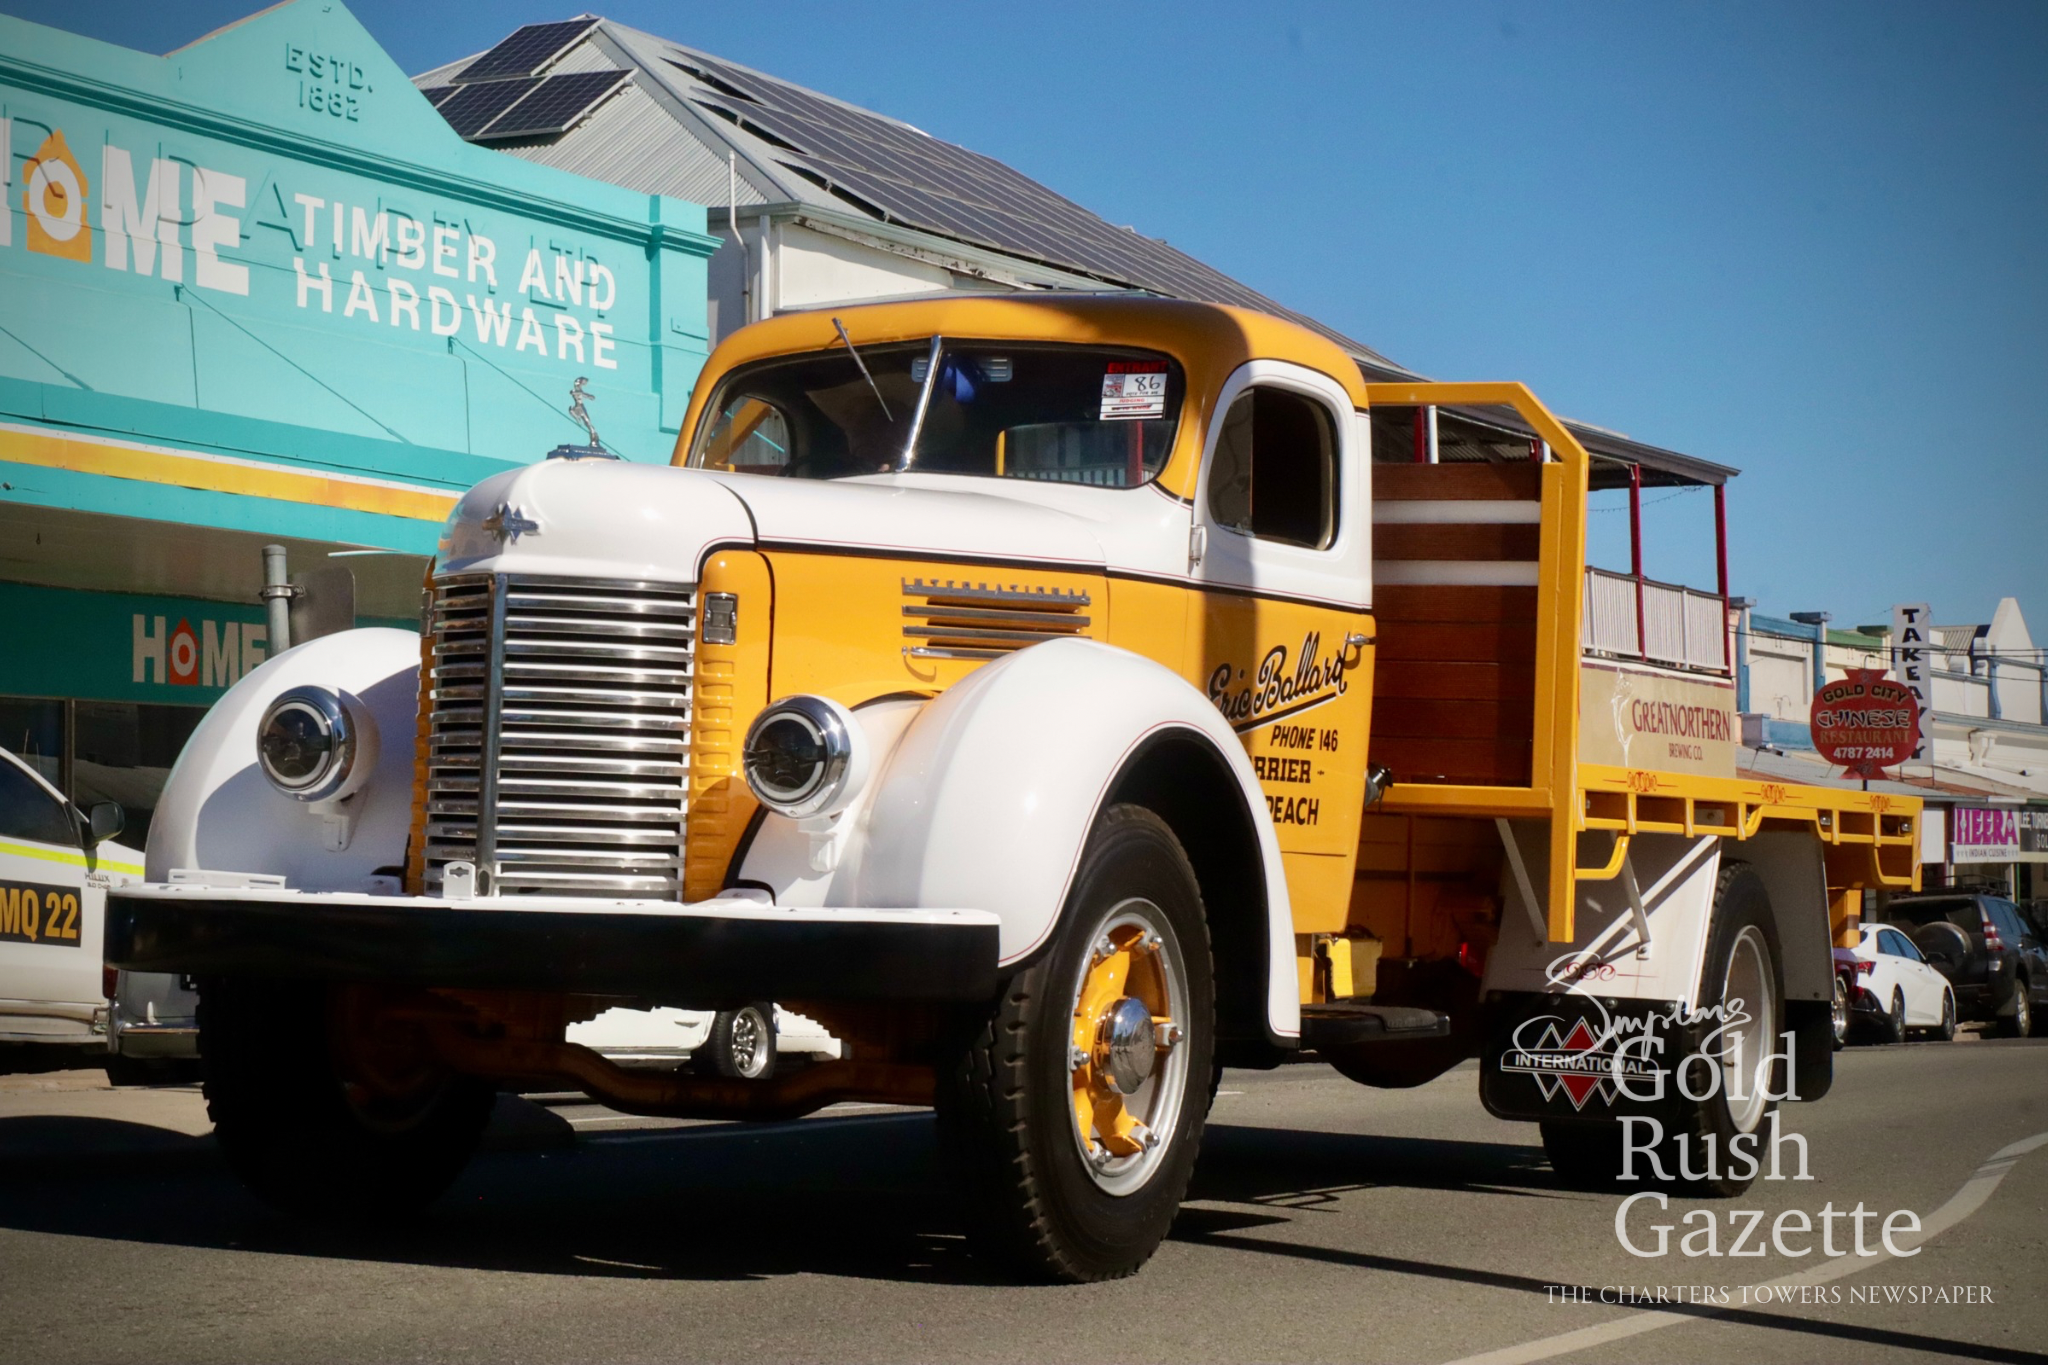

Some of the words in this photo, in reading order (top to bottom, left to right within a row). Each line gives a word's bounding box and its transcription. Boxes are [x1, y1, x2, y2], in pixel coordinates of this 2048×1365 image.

[298, 80, 360, 123] 1882
[294, 192, 498, 287] TIMBER
[518, 248, 616, 312] AND
[292, 256, 618, 370] HARDWARE
[1135, 375, 1161, 391] 86
[132, 613, 267, 688] HOME
[1252, 630, 1350, 717] Ballard
[1822, 683, 1866, 704] GOLD
[1871, 684, 1908, 705] CITY
[1816, 709, 1911, 729] CHINESE
[1270, 725, 1316, 750] PHONE
[1319, 729, 1338, 752] 146
[1819, 730, 1911, 744] RESTAURANT
[1833, 746, 1864, 759] 4787
[1865, 746, 1894, 759] 2414
[1956, 807, 2019, 845] HEERA
[44, 891, 78, 940] 22
[1515, 1053, 1648, 1075] INTERNATIONAL
